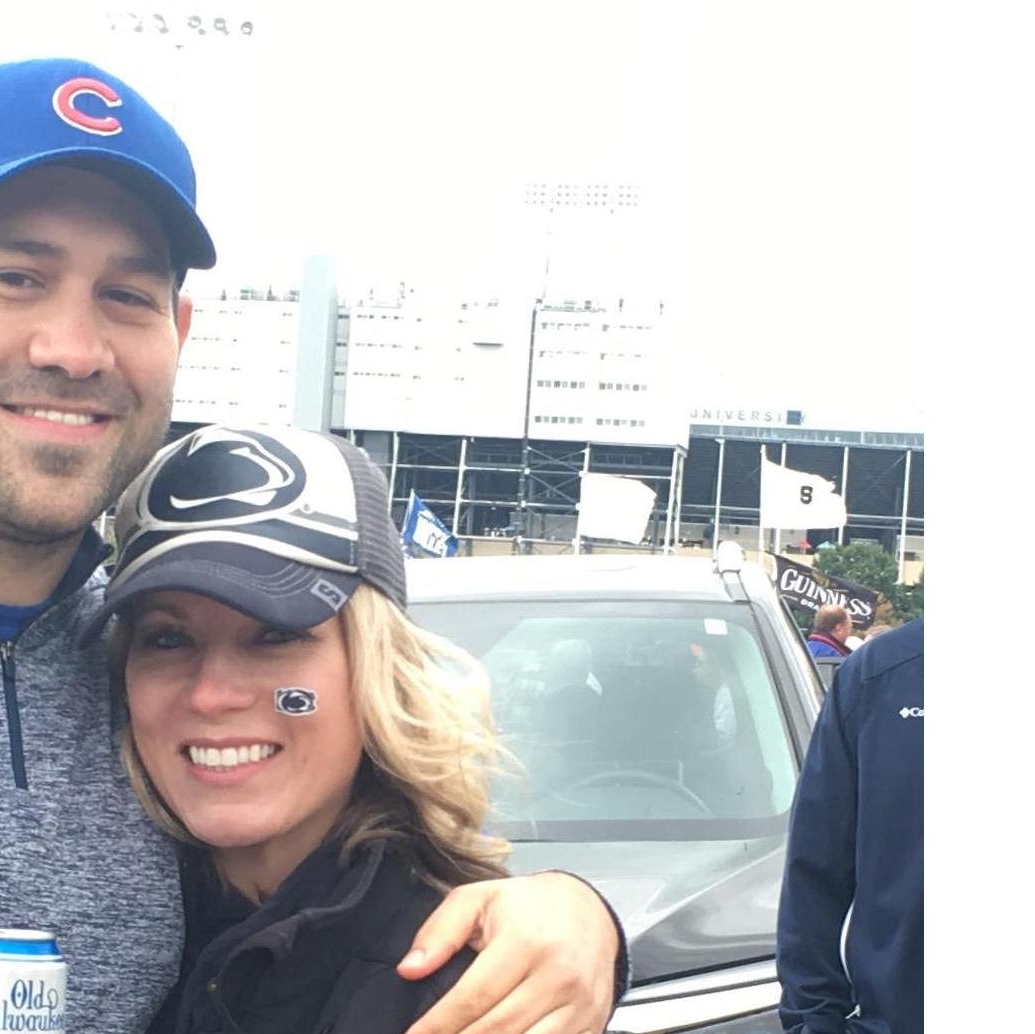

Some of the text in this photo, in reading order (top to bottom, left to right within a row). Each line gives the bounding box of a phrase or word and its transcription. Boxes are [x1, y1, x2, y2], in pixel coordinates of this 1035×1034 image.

[52, 77, 123, 136] C
[800, 485, 813, 505] S
[11, 979, 58, 1010] Old
